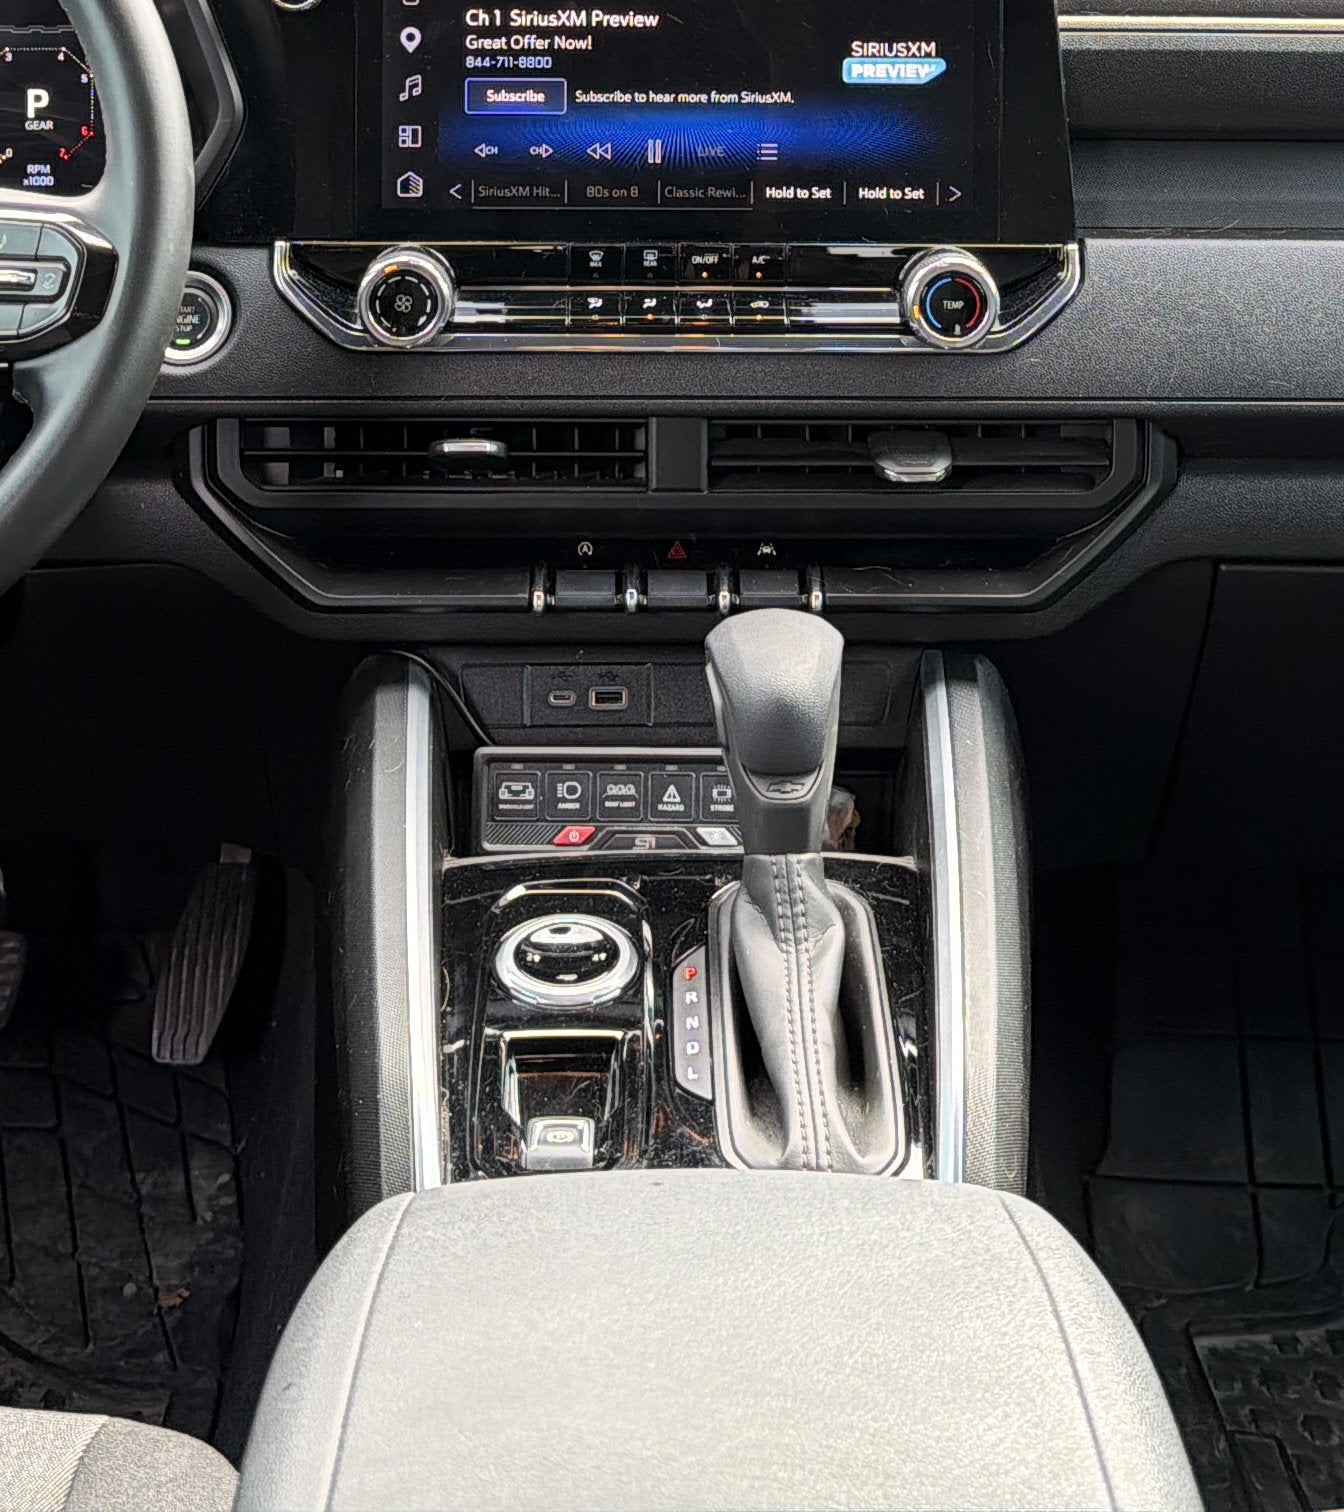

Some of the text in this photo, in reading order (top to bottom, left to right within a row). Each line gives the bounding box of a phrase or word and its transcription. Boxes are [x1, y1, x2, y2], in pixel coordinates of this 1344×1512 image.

[465, 9, 660, 27] Ch 1 SiriusXM Preview
[465, 35, 593, 50] Great Offer Now!
[851, 40, 937, 57] SIRIUSXM
[465, 55, 552, 69] 844-711-8800
[851, 63, 937, 78] PREVIEW
[486, 90, 546, 103] Subscribe
[575, 90, 795, 104] Subscribe to hear more from SiriusXM.
[26, 88, 50, 119] P
[24, 120, 54, 131] GEAR
[486, 146, 498, 155] CH
[529, 146, 543, 156] CH
[26, 164, 51, 174] RPM
[23, 176, 55, 186] x1000
[478, 186, 529, 198] SiriusXM
[586, 186, 639, 198] 80s on 8
[664, 186, 705, 198] Classic
[765, 186, 832, 199] Hold to Set
[858, 187, 925, 200] Hold to Set
[691, 255, 719, 265] ON/OFF
[752, 256, 766, 265] A/C
[943, 300, 965, 310] TEMP
[657, 803, 685, 812] HAZARD
[685, 967, 698, 981] P
[685, 991, 699, 1005] R
[686, 1015, 699, 1030] N
[686, 1041, 700, 1055] D
[687, 1067, 699, 1080] L
